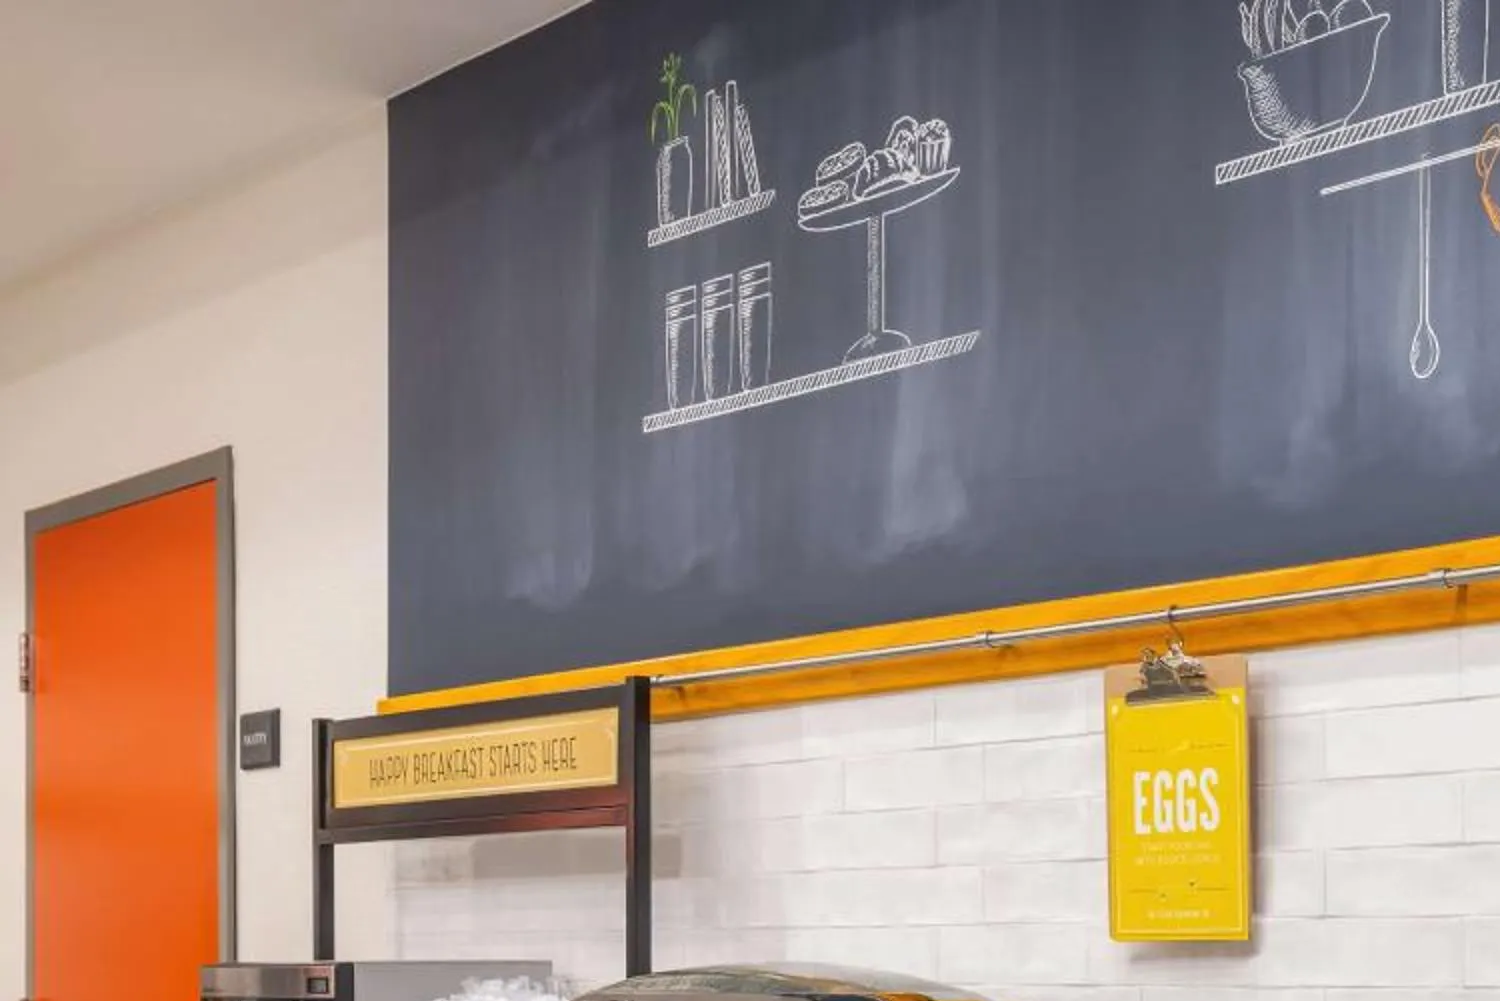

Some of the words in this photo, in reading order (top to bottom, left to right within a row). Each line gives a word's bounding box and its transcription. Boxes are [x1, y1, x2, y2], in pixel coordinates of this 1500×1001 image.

[369, 755, 409, 789] HAPPY
[413, 747, 484, 784] BREAKFAST
[488, 743, 537, 778] STARTS
[542, 737, 577, 771] HERE
[1133, 767, 1220, 835] EGGS
